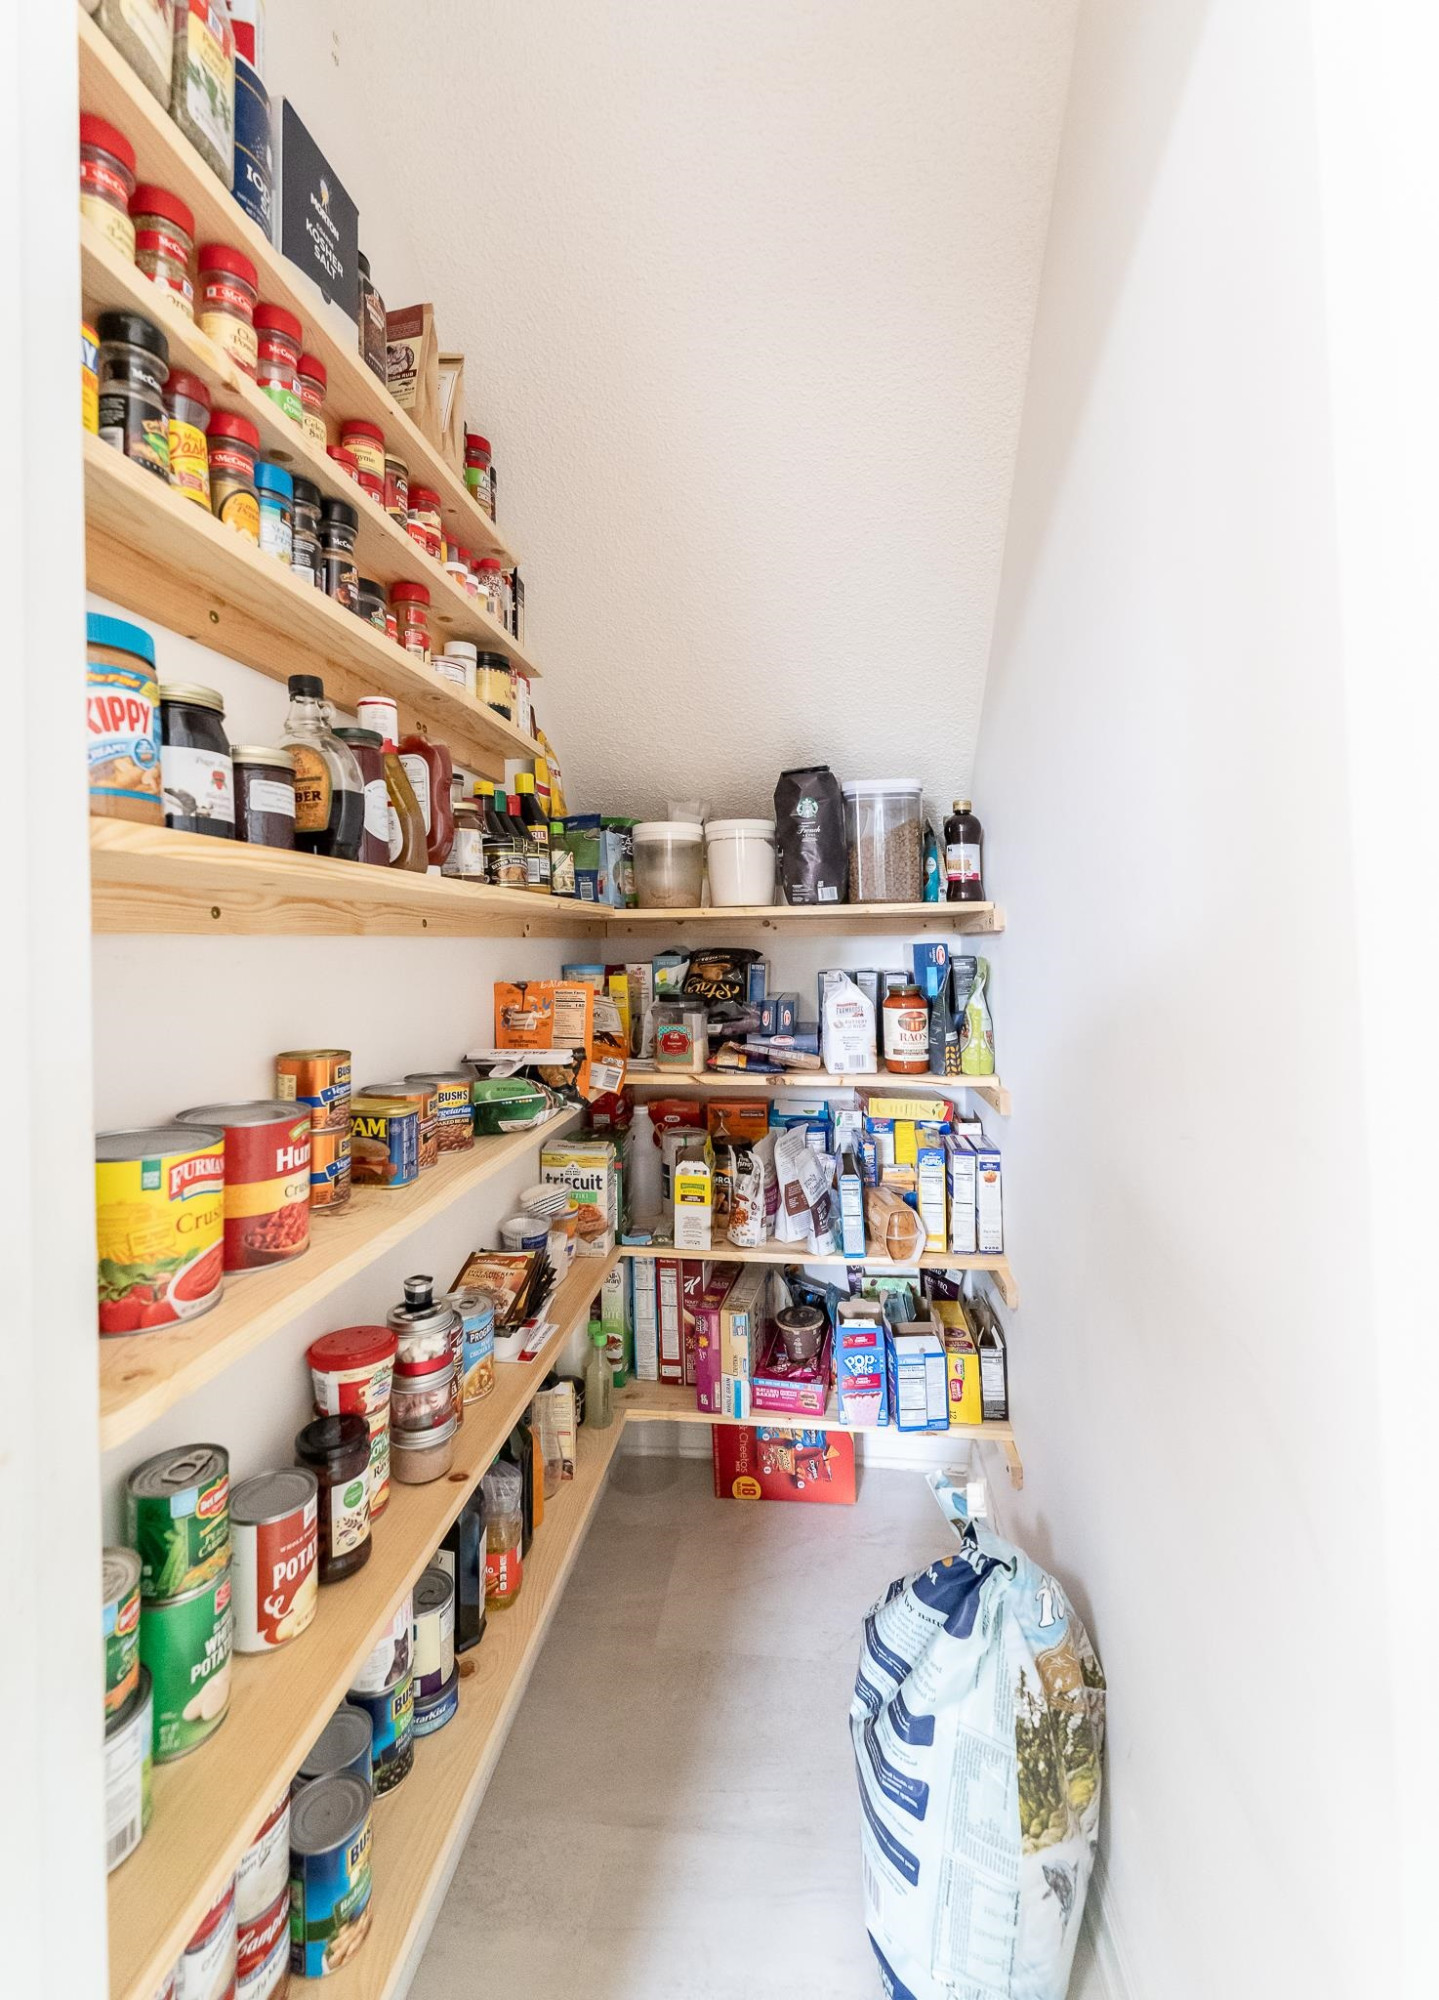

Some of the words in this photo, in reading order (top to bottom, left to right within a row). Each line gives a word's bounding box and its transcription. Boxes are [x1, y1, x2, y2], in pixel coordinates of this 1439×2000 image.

[305, 218, 345, 279] KOSHER
[313, 244, 337, 280] SALT
[545, 1172, 603, 1190] triscuit
[684, 1276, 701, 1295] K
[739, 1434, 748, 1473] Cheetos
